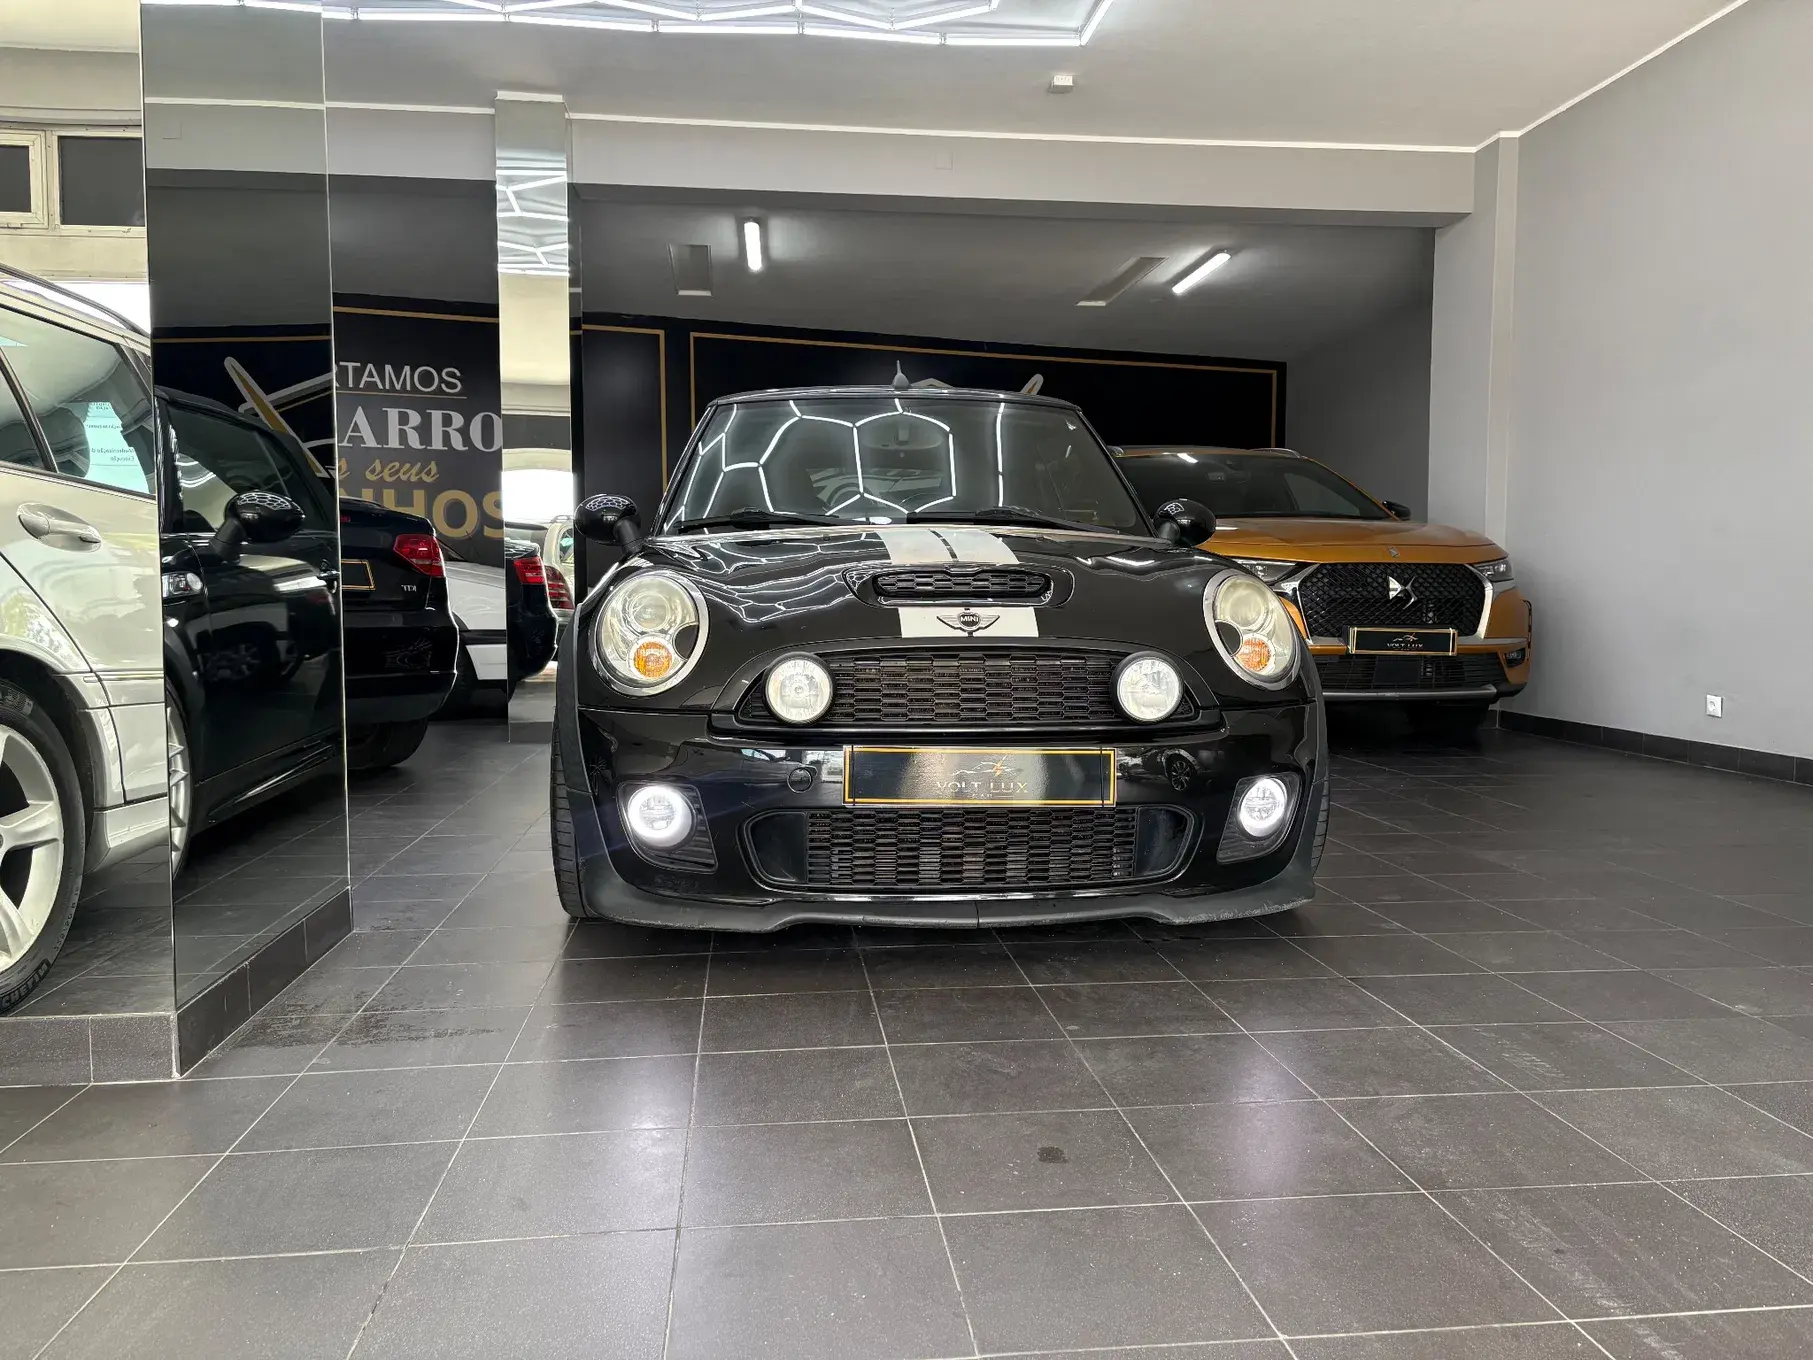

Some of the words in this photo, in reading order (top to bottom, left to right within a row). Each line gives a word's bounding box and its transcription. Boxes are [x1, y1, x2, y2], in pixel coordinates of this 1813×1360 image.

[335, 361, 463, 394] TAMOS
[365, 458, 441, 484] seus
[960, 614, 979, 622] MINI
[936, 781, 982, 793] VOLT
[989, 781, 1028, 793] LUX
